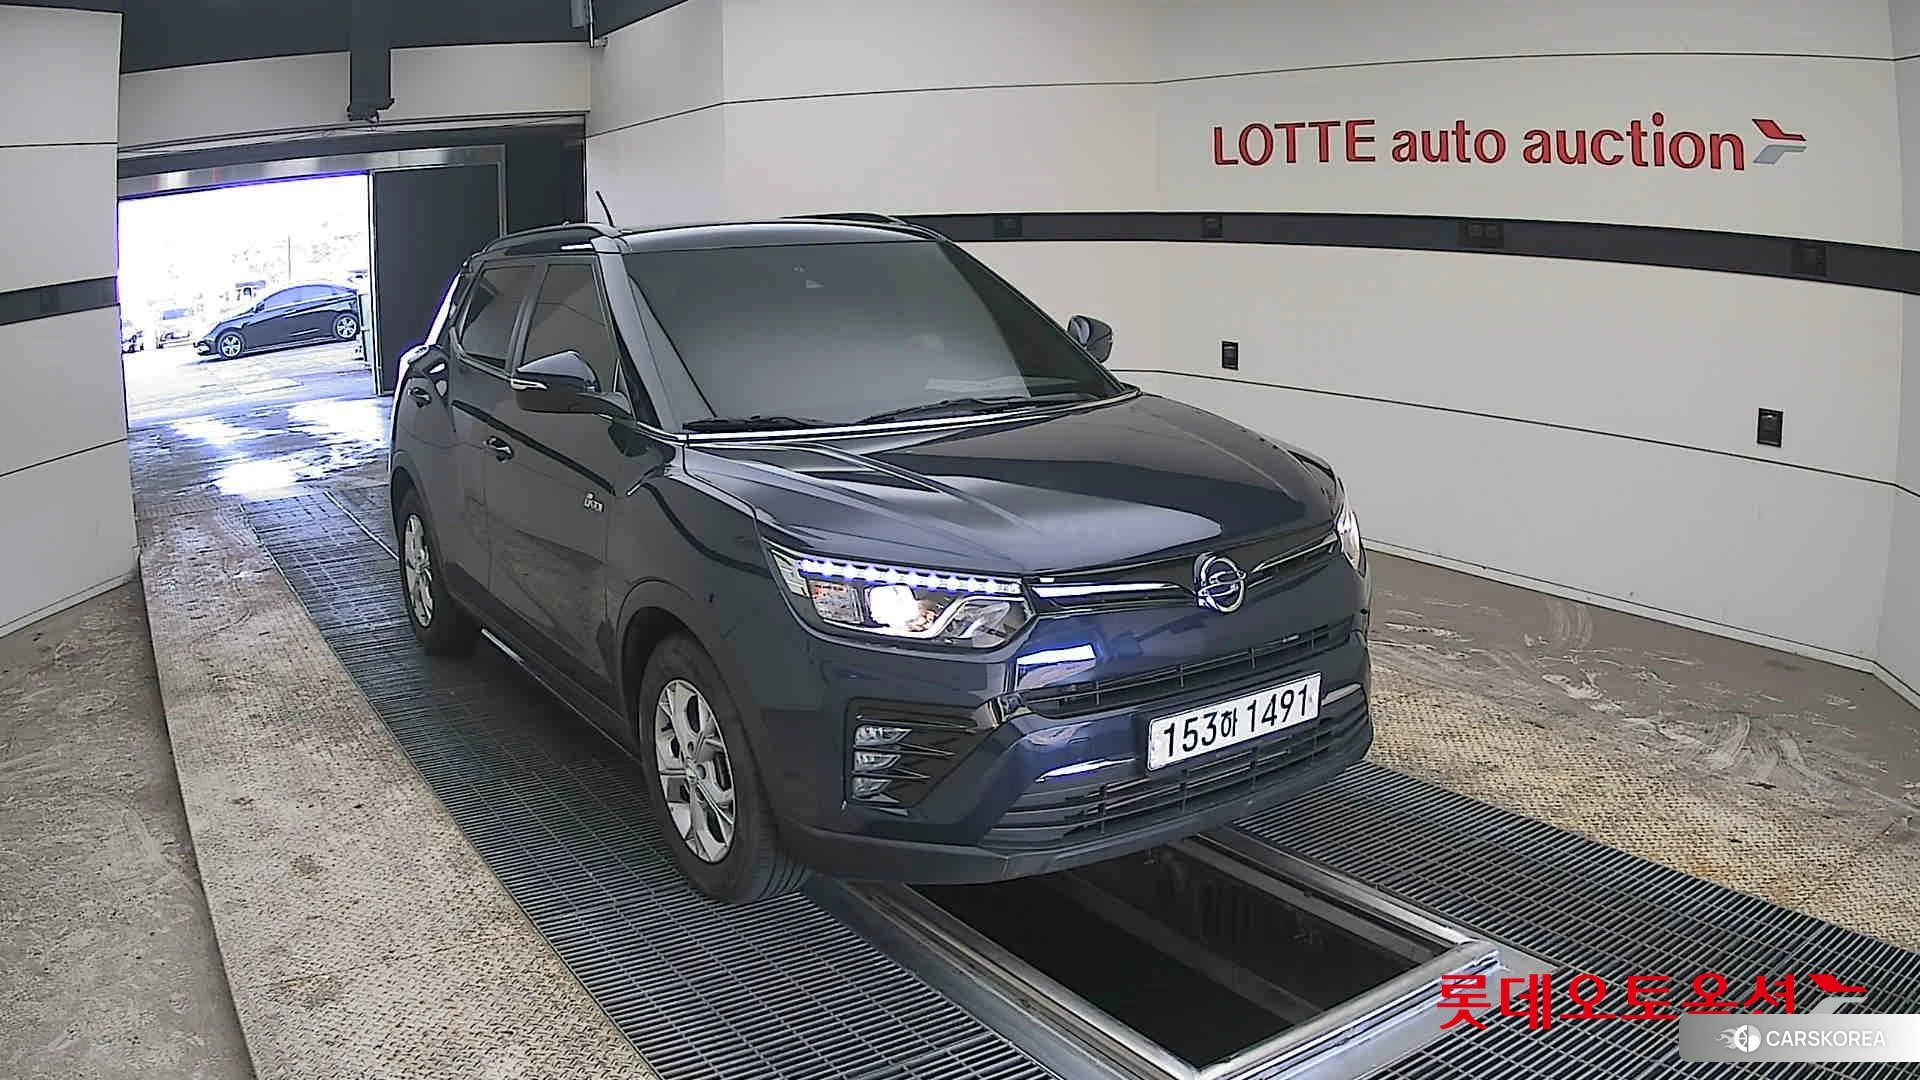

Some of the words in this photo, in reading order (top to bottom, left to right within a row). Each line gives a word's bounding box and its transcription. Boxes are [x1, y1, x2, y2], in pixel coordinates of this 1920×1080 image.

[1213, 119, 1377, 166] LOTTE
[1392, 118, 1507, 165] auto
[1522, 112, 1746, 171] auction
[1163, 707, 1238, 757] 153하
[1246, 684, 1309, 732] 1491
